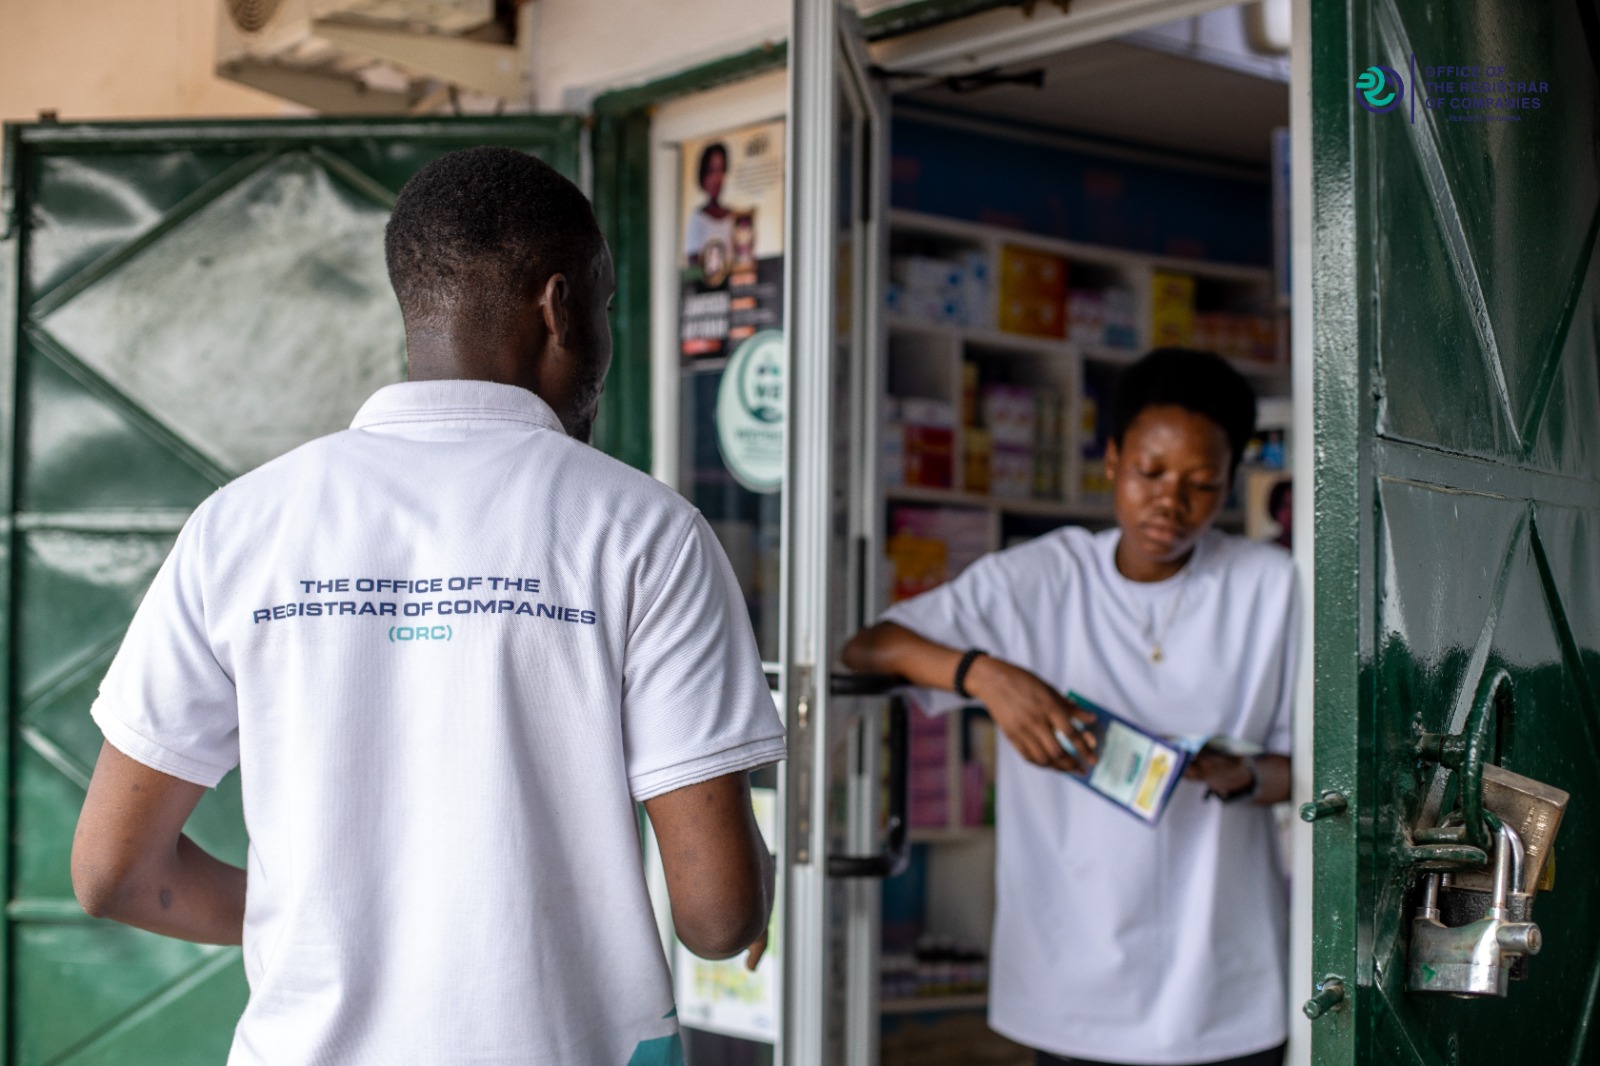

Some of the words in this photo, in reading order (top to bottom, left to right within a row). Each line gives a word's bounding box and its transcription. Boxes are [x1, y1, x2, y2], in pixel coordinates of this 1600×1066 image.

[300, 579, 350, 593] THE
[355, 578, 443, 594] OFFICE
[448, 577, 483, 591] OF
[487, 577, 541, 593] THE
[253, 601, 397, 624] REGISTRAR
[403, 602, 433, 616] OF
[437, 600, 596, 625] COMPANIES
[389, 625, 453, 642] (ORC)
